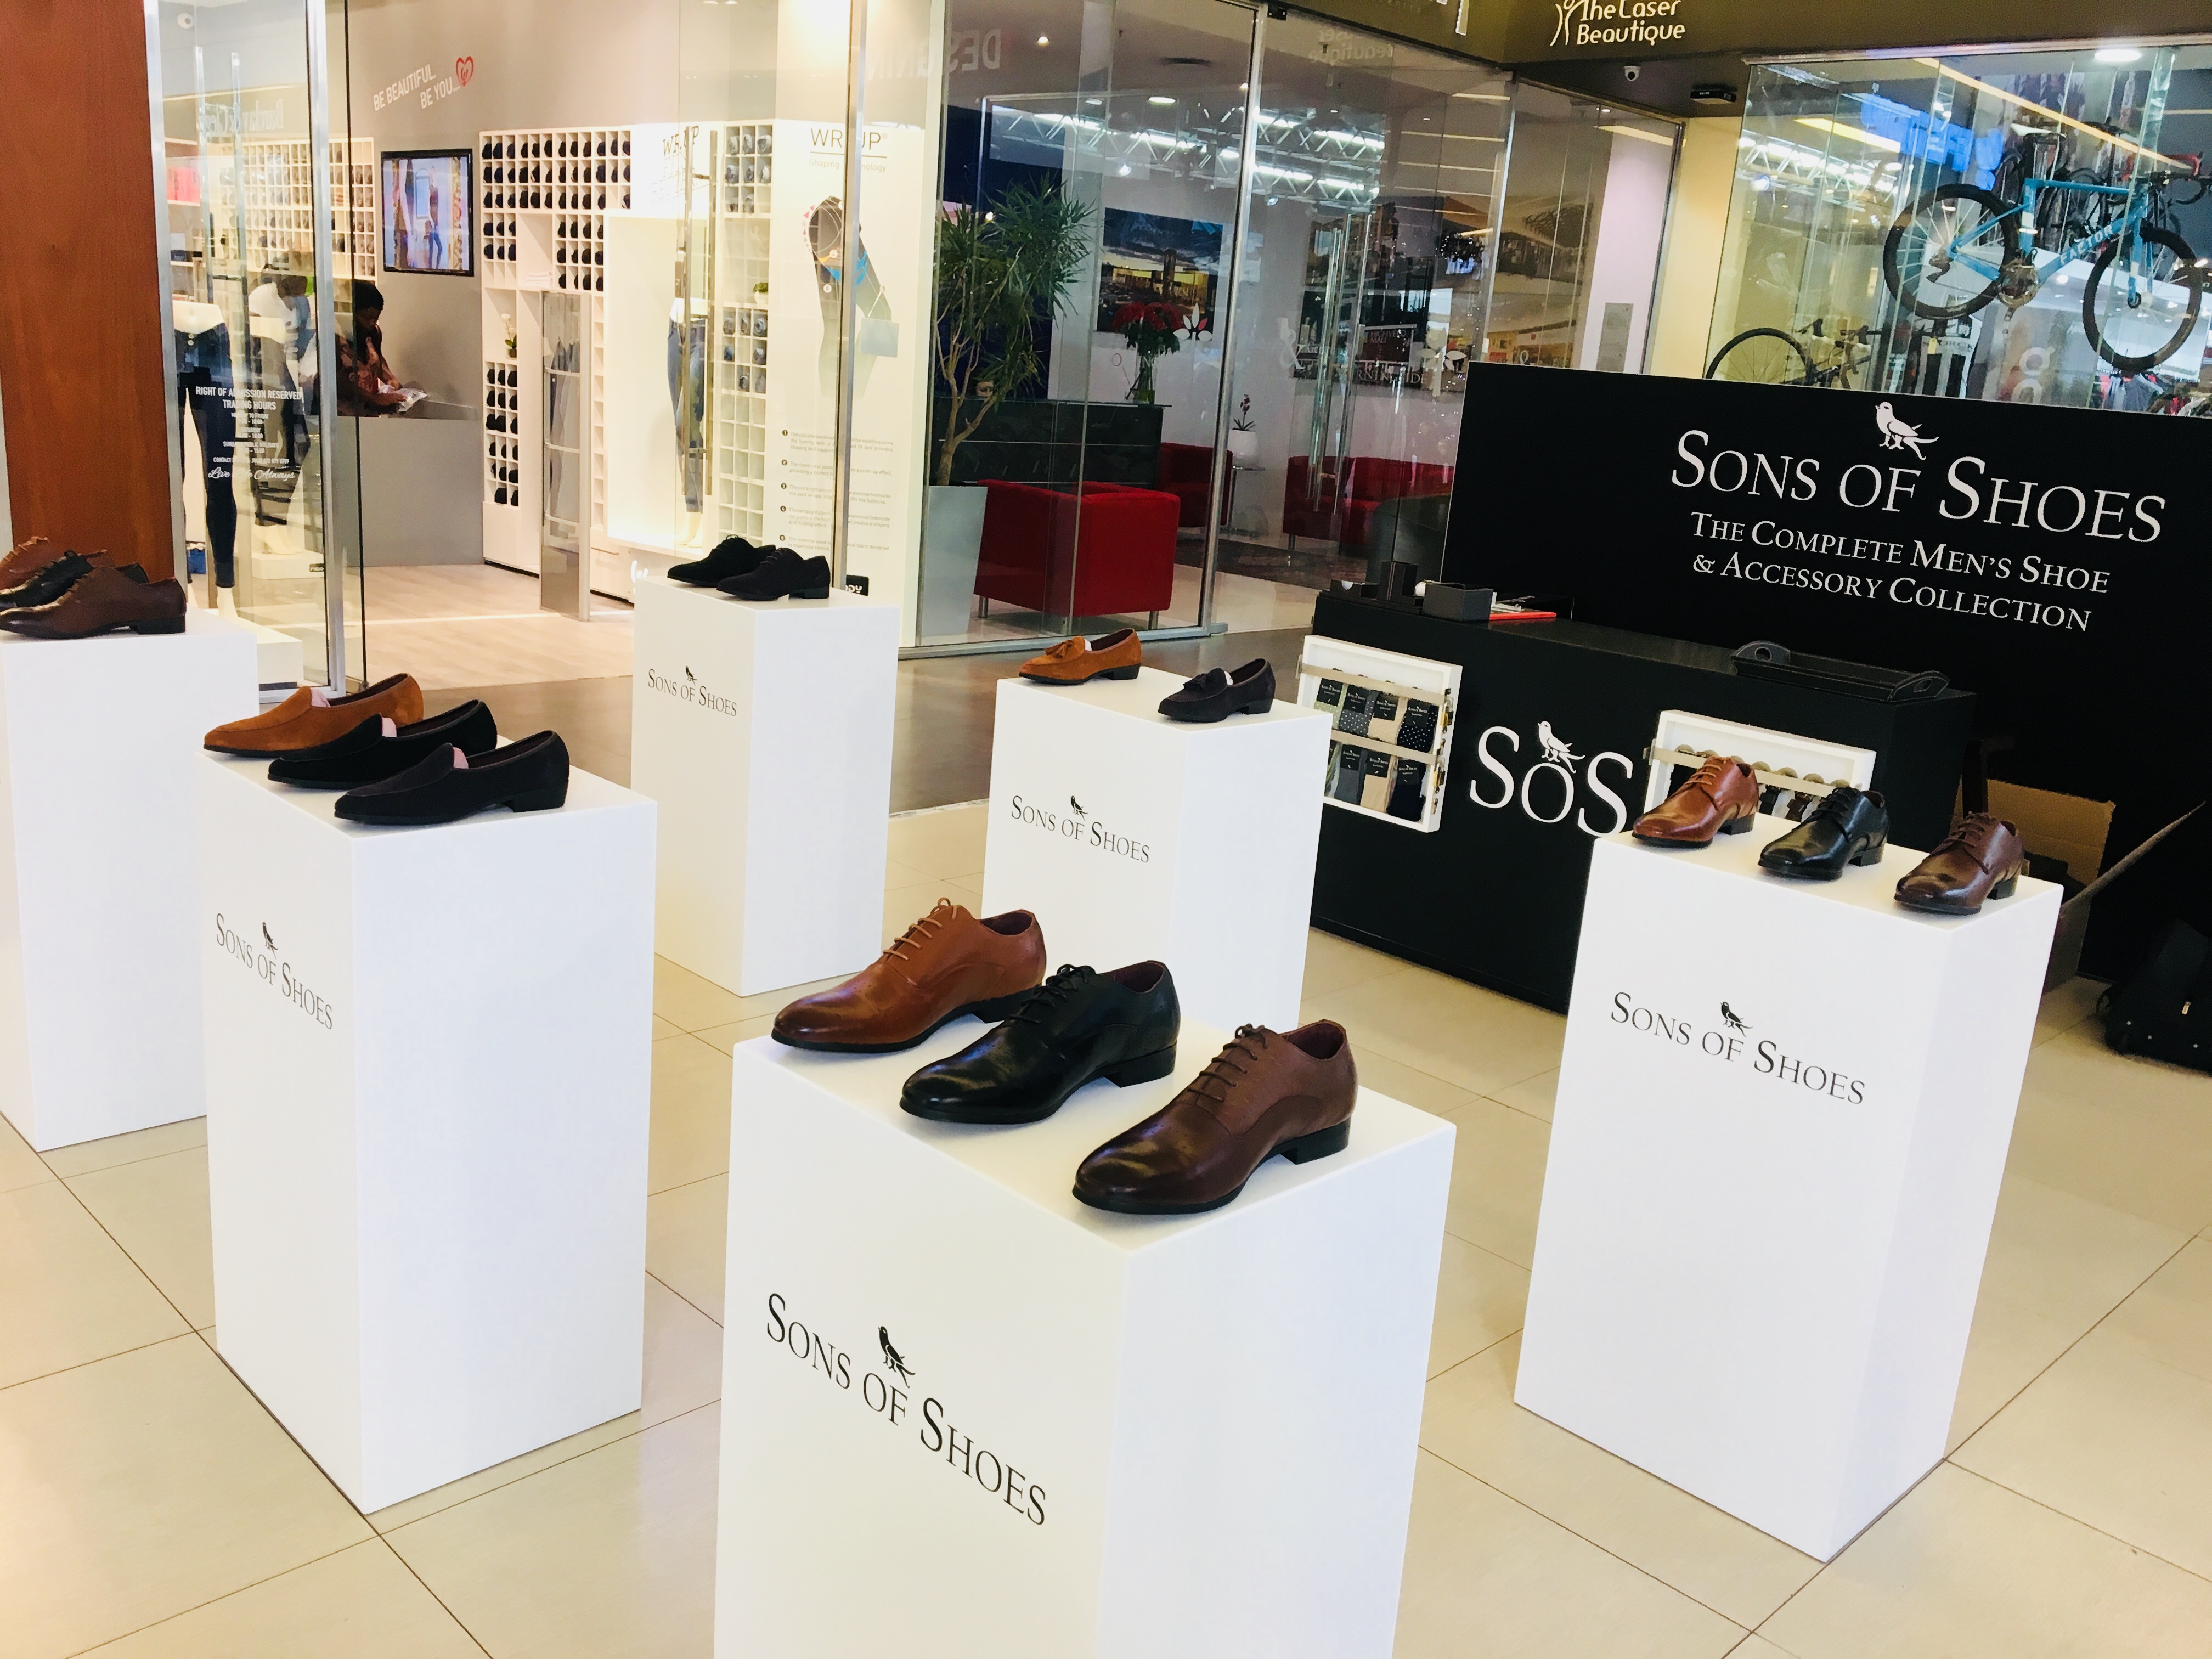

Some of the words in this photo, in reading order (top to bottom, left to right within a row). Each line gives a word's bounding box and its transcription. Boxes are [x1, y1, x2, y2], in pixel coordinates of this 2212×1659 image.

[1577, 20, 1686, 46] Beautique
[1581, 0, 1617, 21] The
[1619, 0, 1681, 18] Laser
[373, 91, 386, 111] BE
[386, 64, 436, 104] BEAUTIFUL.
[420, 88, 433, 109] BE
[811, 128, 881, 150] WRP
[809, 159, 840, 170] Shaping
[2060, 224, 2113, 265] FACTOR
[196, 386, 216, 396] RIGHT
[218, 387, 227, 396] OF
[268, 390, 301, 400] RESERVED
[223, 399, 252, 409] TRADING
[253, 401, 276, 410] HOURS
[208, 467, 230, 478] Live
[254, 469, 296, 481] Always
[1672, 430, 1820, 501] SONS
[1839, 464, 1921, 512] OF
[1939, 456, 2166, 544] SHOES
[1691, 511, 1745, 543] THE
[1752, 521, 1904, 564] COMPLETE
[1910, 540, 2011, 580] MEN'S
[2020, 555, 2111, 594] SHOE
[1693, 554, 1714, 574] &
[1721, 552, 1884, 600] ACCESSORY
[1889, 577, 2092, 632] COLLECTION
[648, 668, 677, 696] SONS
[680, 685, 696, 702] OF
[699, 685, 737, 717] SHOES
[1469, 726, 1633, 837] SOS
[1011, 795, 1056, 831] SONS
[1062, 819, 1085, 840] OF
[1090, 821, 1150, 863] SHOES
[216, 913, 253, 968] SONS
[257, 954, 276, 986] OF
[281, 962, 332, 1030] SHOES
[1611, 992, 1692, 1046] SONS
[1702, 1031, 1745, 1062] OF
[1753, 1040, 1865, 1105] SHOES
[767, 1293, 851, 1389] SONS
[863, 1372, 909, 1426] OF
[920, 1397, 1046, 1525] SHOES
